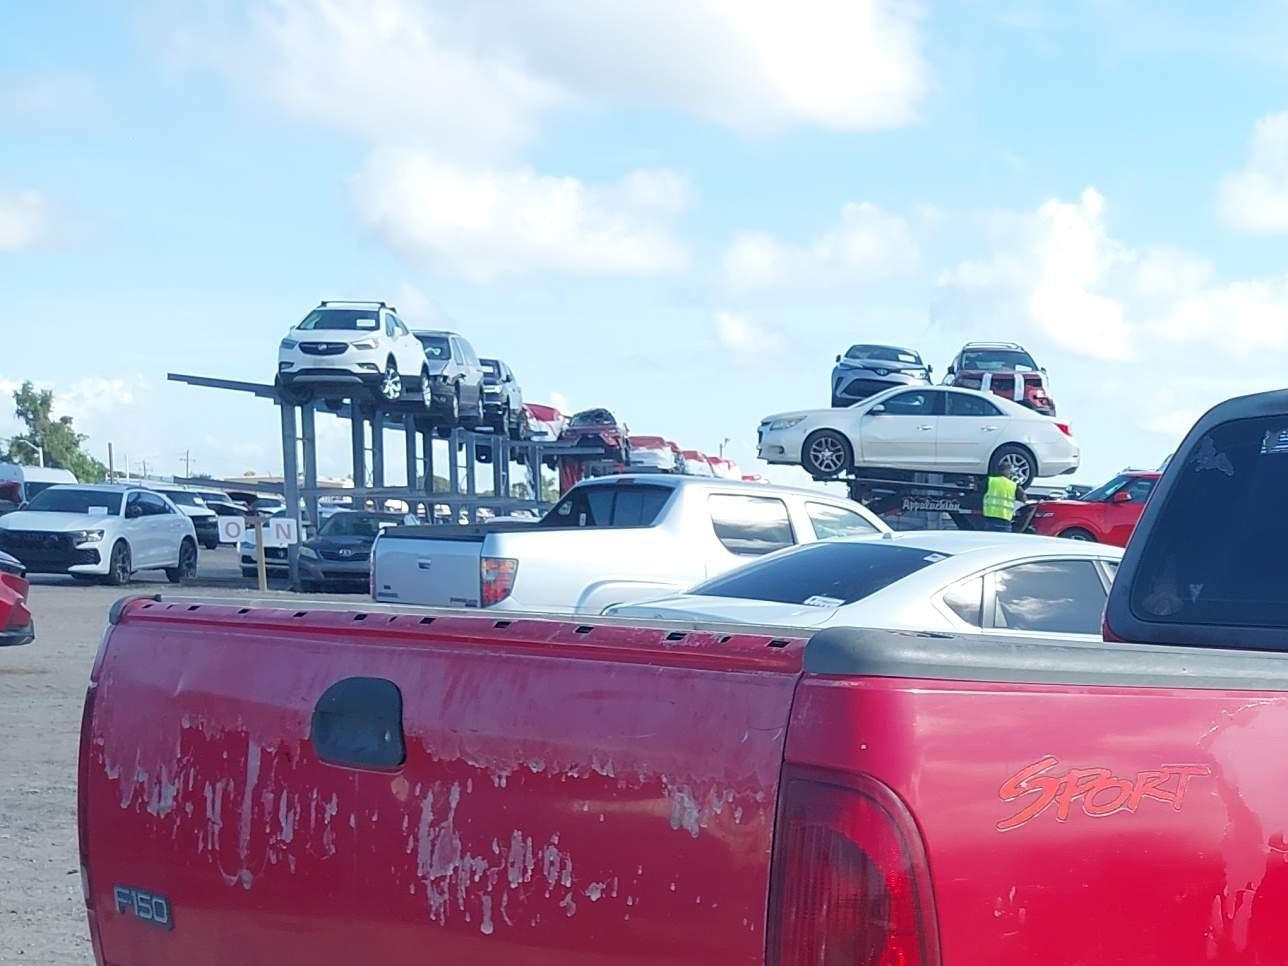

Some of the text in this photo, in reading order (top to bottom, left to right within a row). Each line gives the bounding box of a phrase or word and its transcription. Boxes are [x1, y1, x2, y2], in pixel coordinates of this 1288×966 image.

[225, 521, 241, 538] O
[275, 523, 291, 540] N
[995, 754, 1212, 832] SPORT
